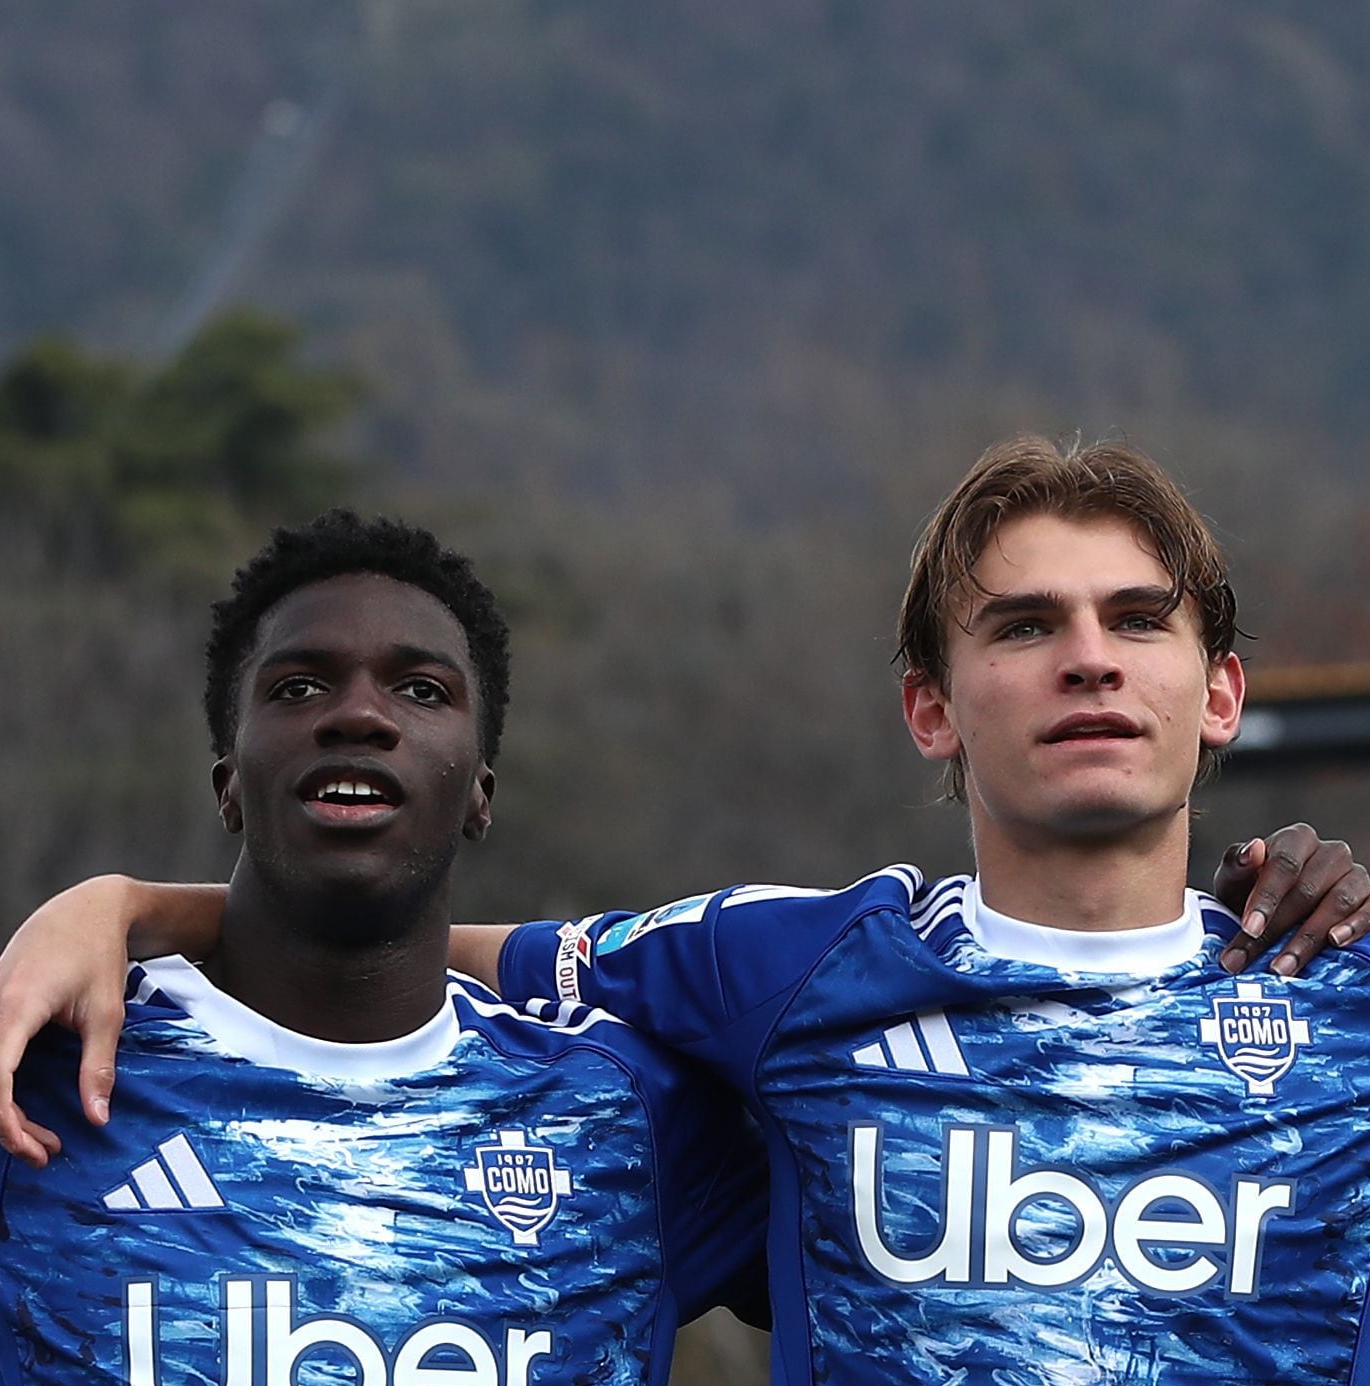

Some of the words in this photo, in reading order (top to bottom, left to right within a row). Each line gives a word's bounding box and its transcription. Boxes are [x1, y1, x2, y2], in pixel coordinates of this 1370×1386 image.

[559, 966, 578, 999] OUT
[1233, 1006, 1271, 1018] 1907
[1223, 1018, 1288, 1045] COMO
[497, 1154, 534, 1166] 1907
[487, 1167, 549, 1195] COMO
[852, 1126, 1290, 1295] Uber
